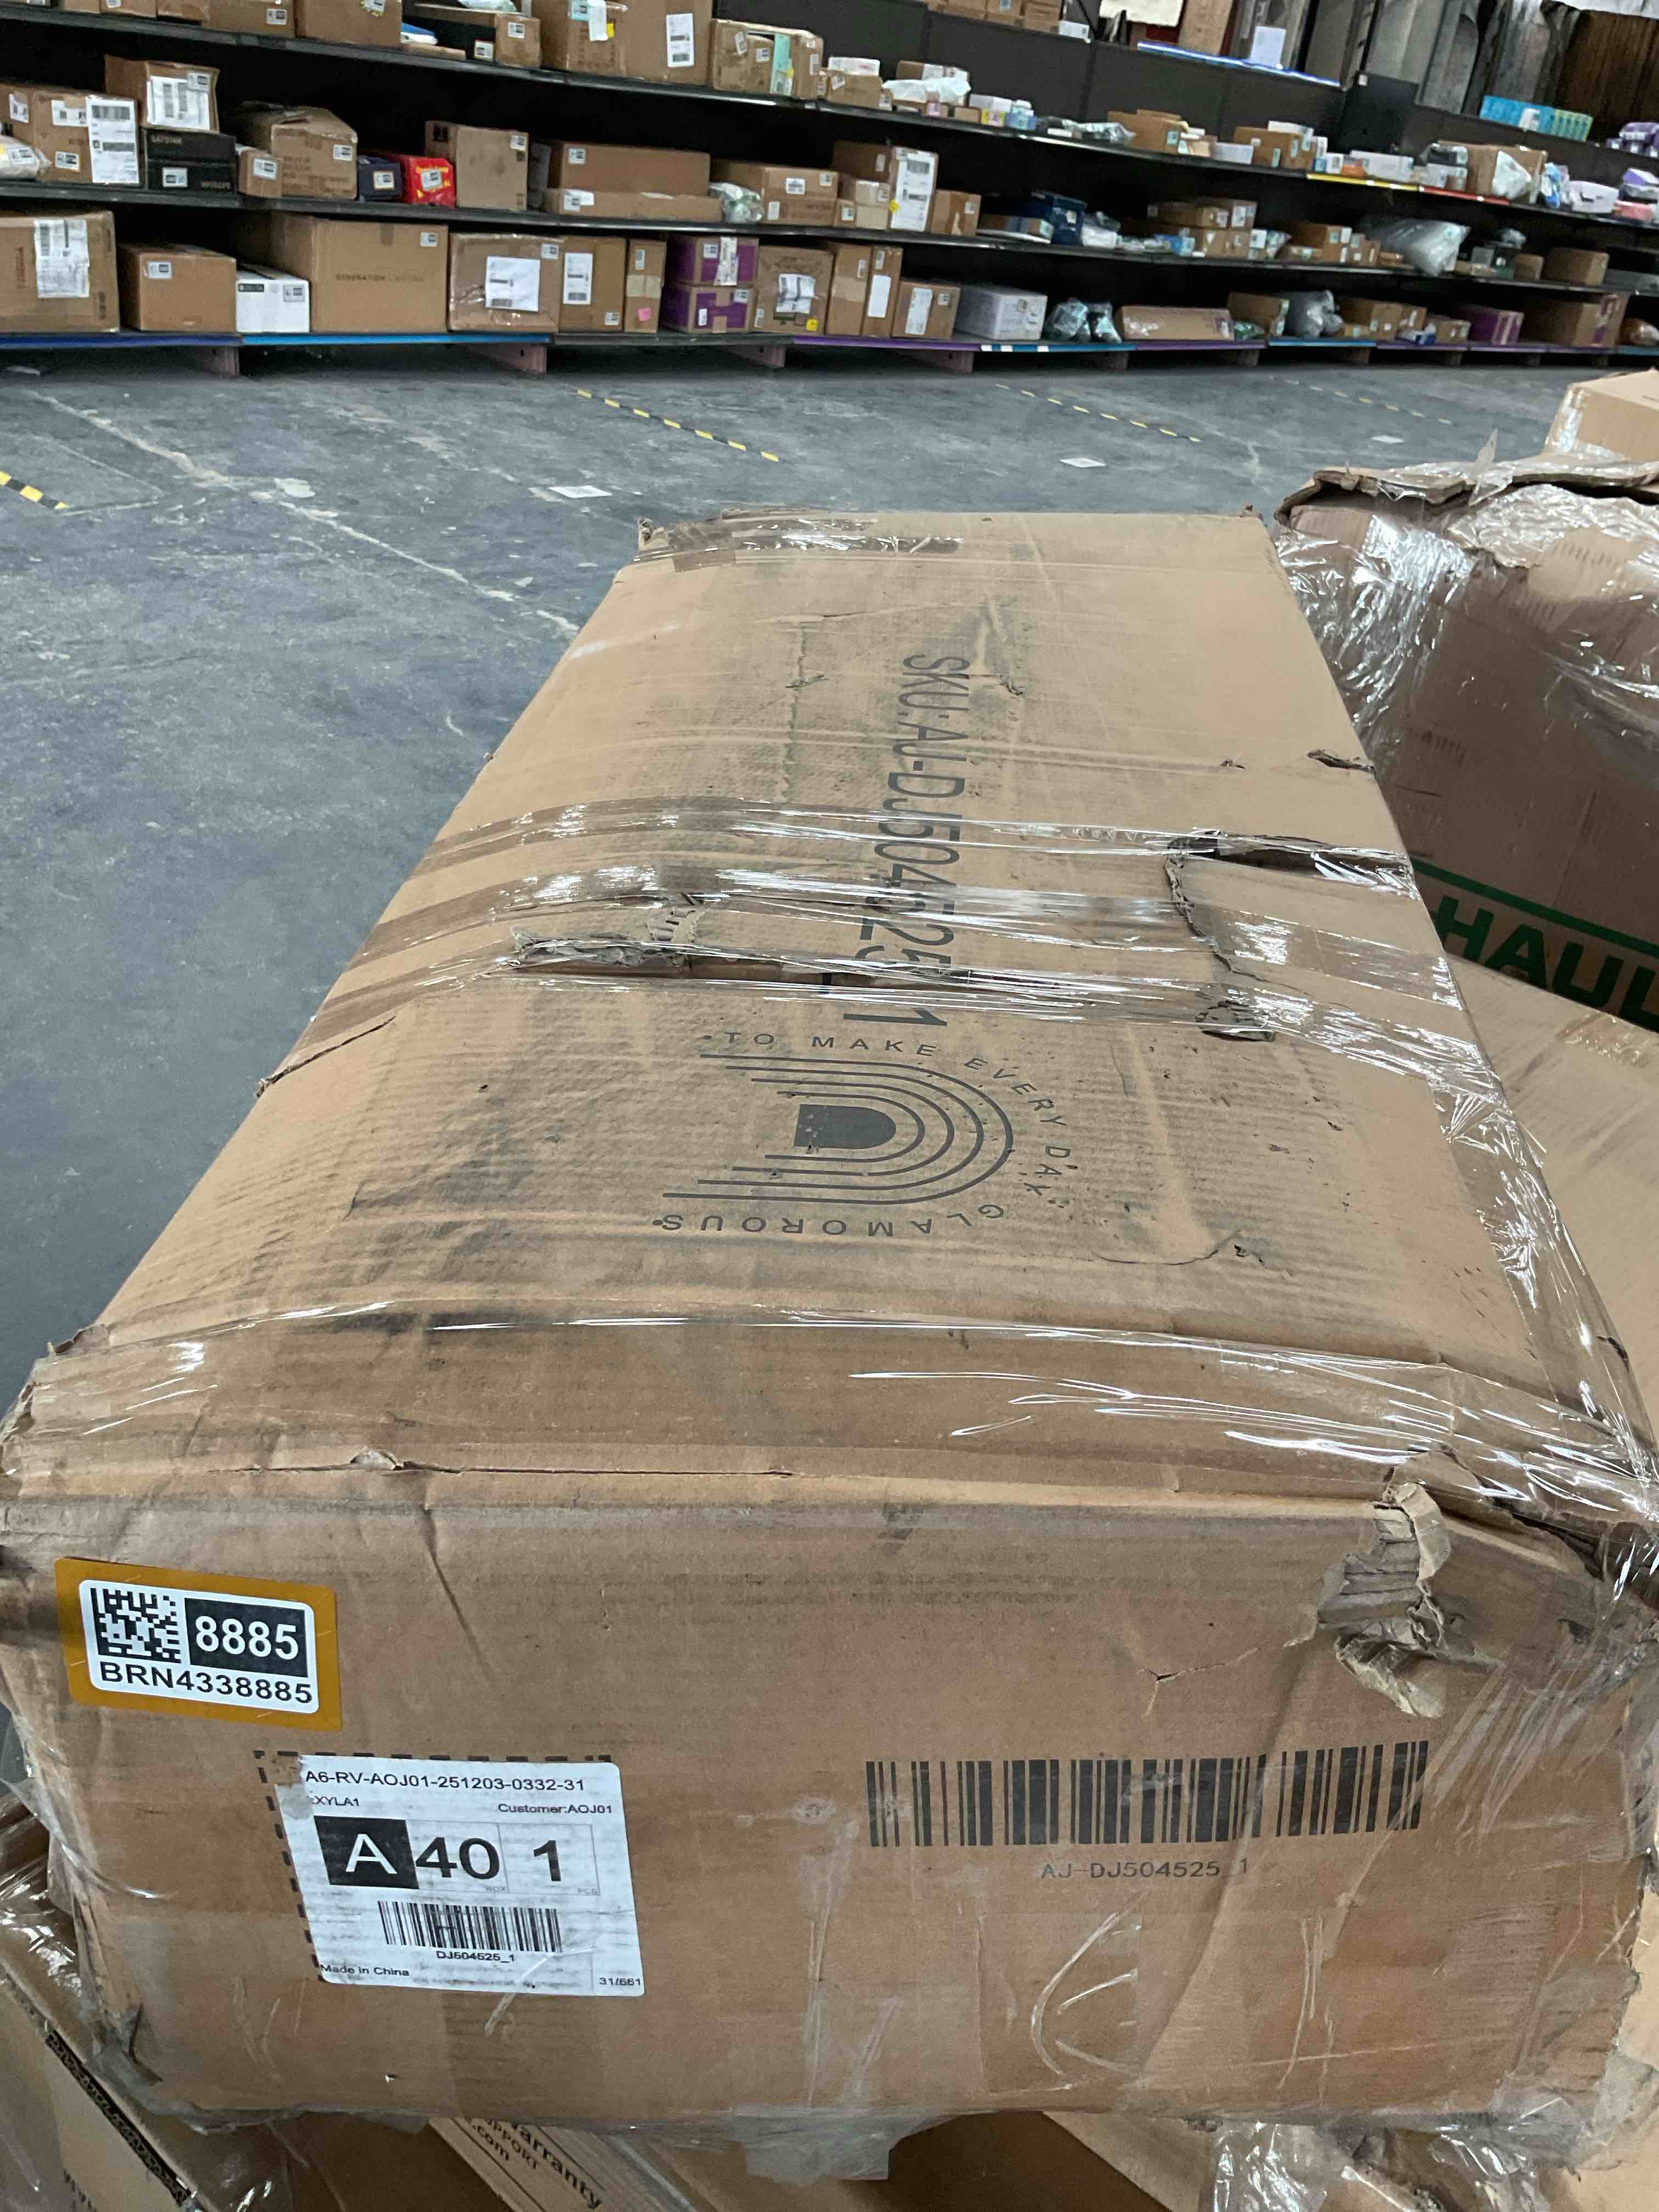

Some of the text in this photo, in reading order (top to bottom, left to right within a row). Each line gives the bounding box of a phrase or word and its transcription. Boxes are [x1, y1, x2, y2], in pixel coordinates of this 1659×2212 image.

[661, 1031, 1071, 1238] TO MAKE EVERY DAY GLAMOROUS
[194, 1615, 299, 1660] 8885
[100, 1661, 312, 1704] BRN4338885
[306, 1770, 585, 1791] A6-RV-AOJ01-251203-0332-31
[311, 1795, 359, 1807] XYLA1
[498, 1803, 612, 1814] Customer:AOJ01
[345, 1833, 398, 1875] A
[415, 1836, 562, 1882] 40 1
[320, 1964, 410, 1976] Made in China
[436, 1950, 515, 1963] DJ504525_1
[599, 1977, 641, 1986] 31/661
[486, 2118, 537, 2169] PPORT
[511, 2121, 601, 2210] arranty
